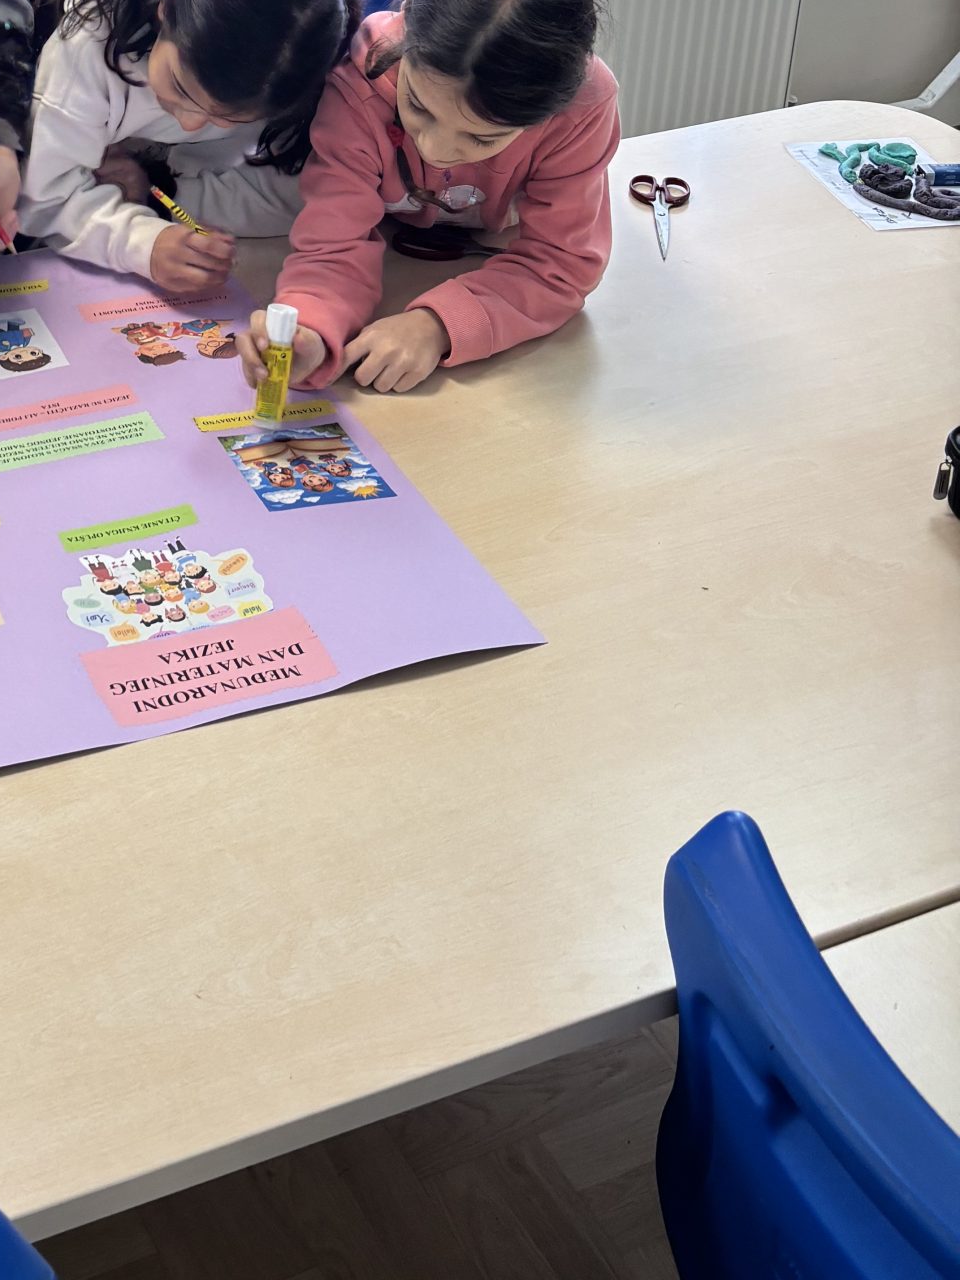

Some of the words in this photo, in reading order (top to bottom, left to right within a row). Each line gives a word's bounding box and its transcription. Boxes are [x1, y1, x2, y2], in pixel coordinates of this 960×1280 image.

[41, 402, 60, 410] ISTA
[118, 420, 143, 430] SAMO
[202, 416, 241, 426] ZABAVNO
[62, 426, 116, 440] POSTOJANJE
[109, 427, 144, 437] VEZANA
[26, 437, 61, 447] JEDNOG
[68, 437, 94, 445] SAMO
[0, 449, 24, 458] NEGO
[25, 442, 67, 454] KULTURA
[53, 444, 82, 454] SNAGA
[12, 452, 45, 462] KOJOM
[140, 515, 181, 529] ČITANJE
[105, 524, 139, 536] KNJIGA
[67, 532, 103, 543] OPUŠTA
[243, 605, 262, 616] Hola!
[157, 638, 235, 665] JEZIKA
[257, 642, 305, 664] DAN
[109, 655, 253, 696] MATERINJEG
[132, 665, 303, 713] MEĐUNARODNI
